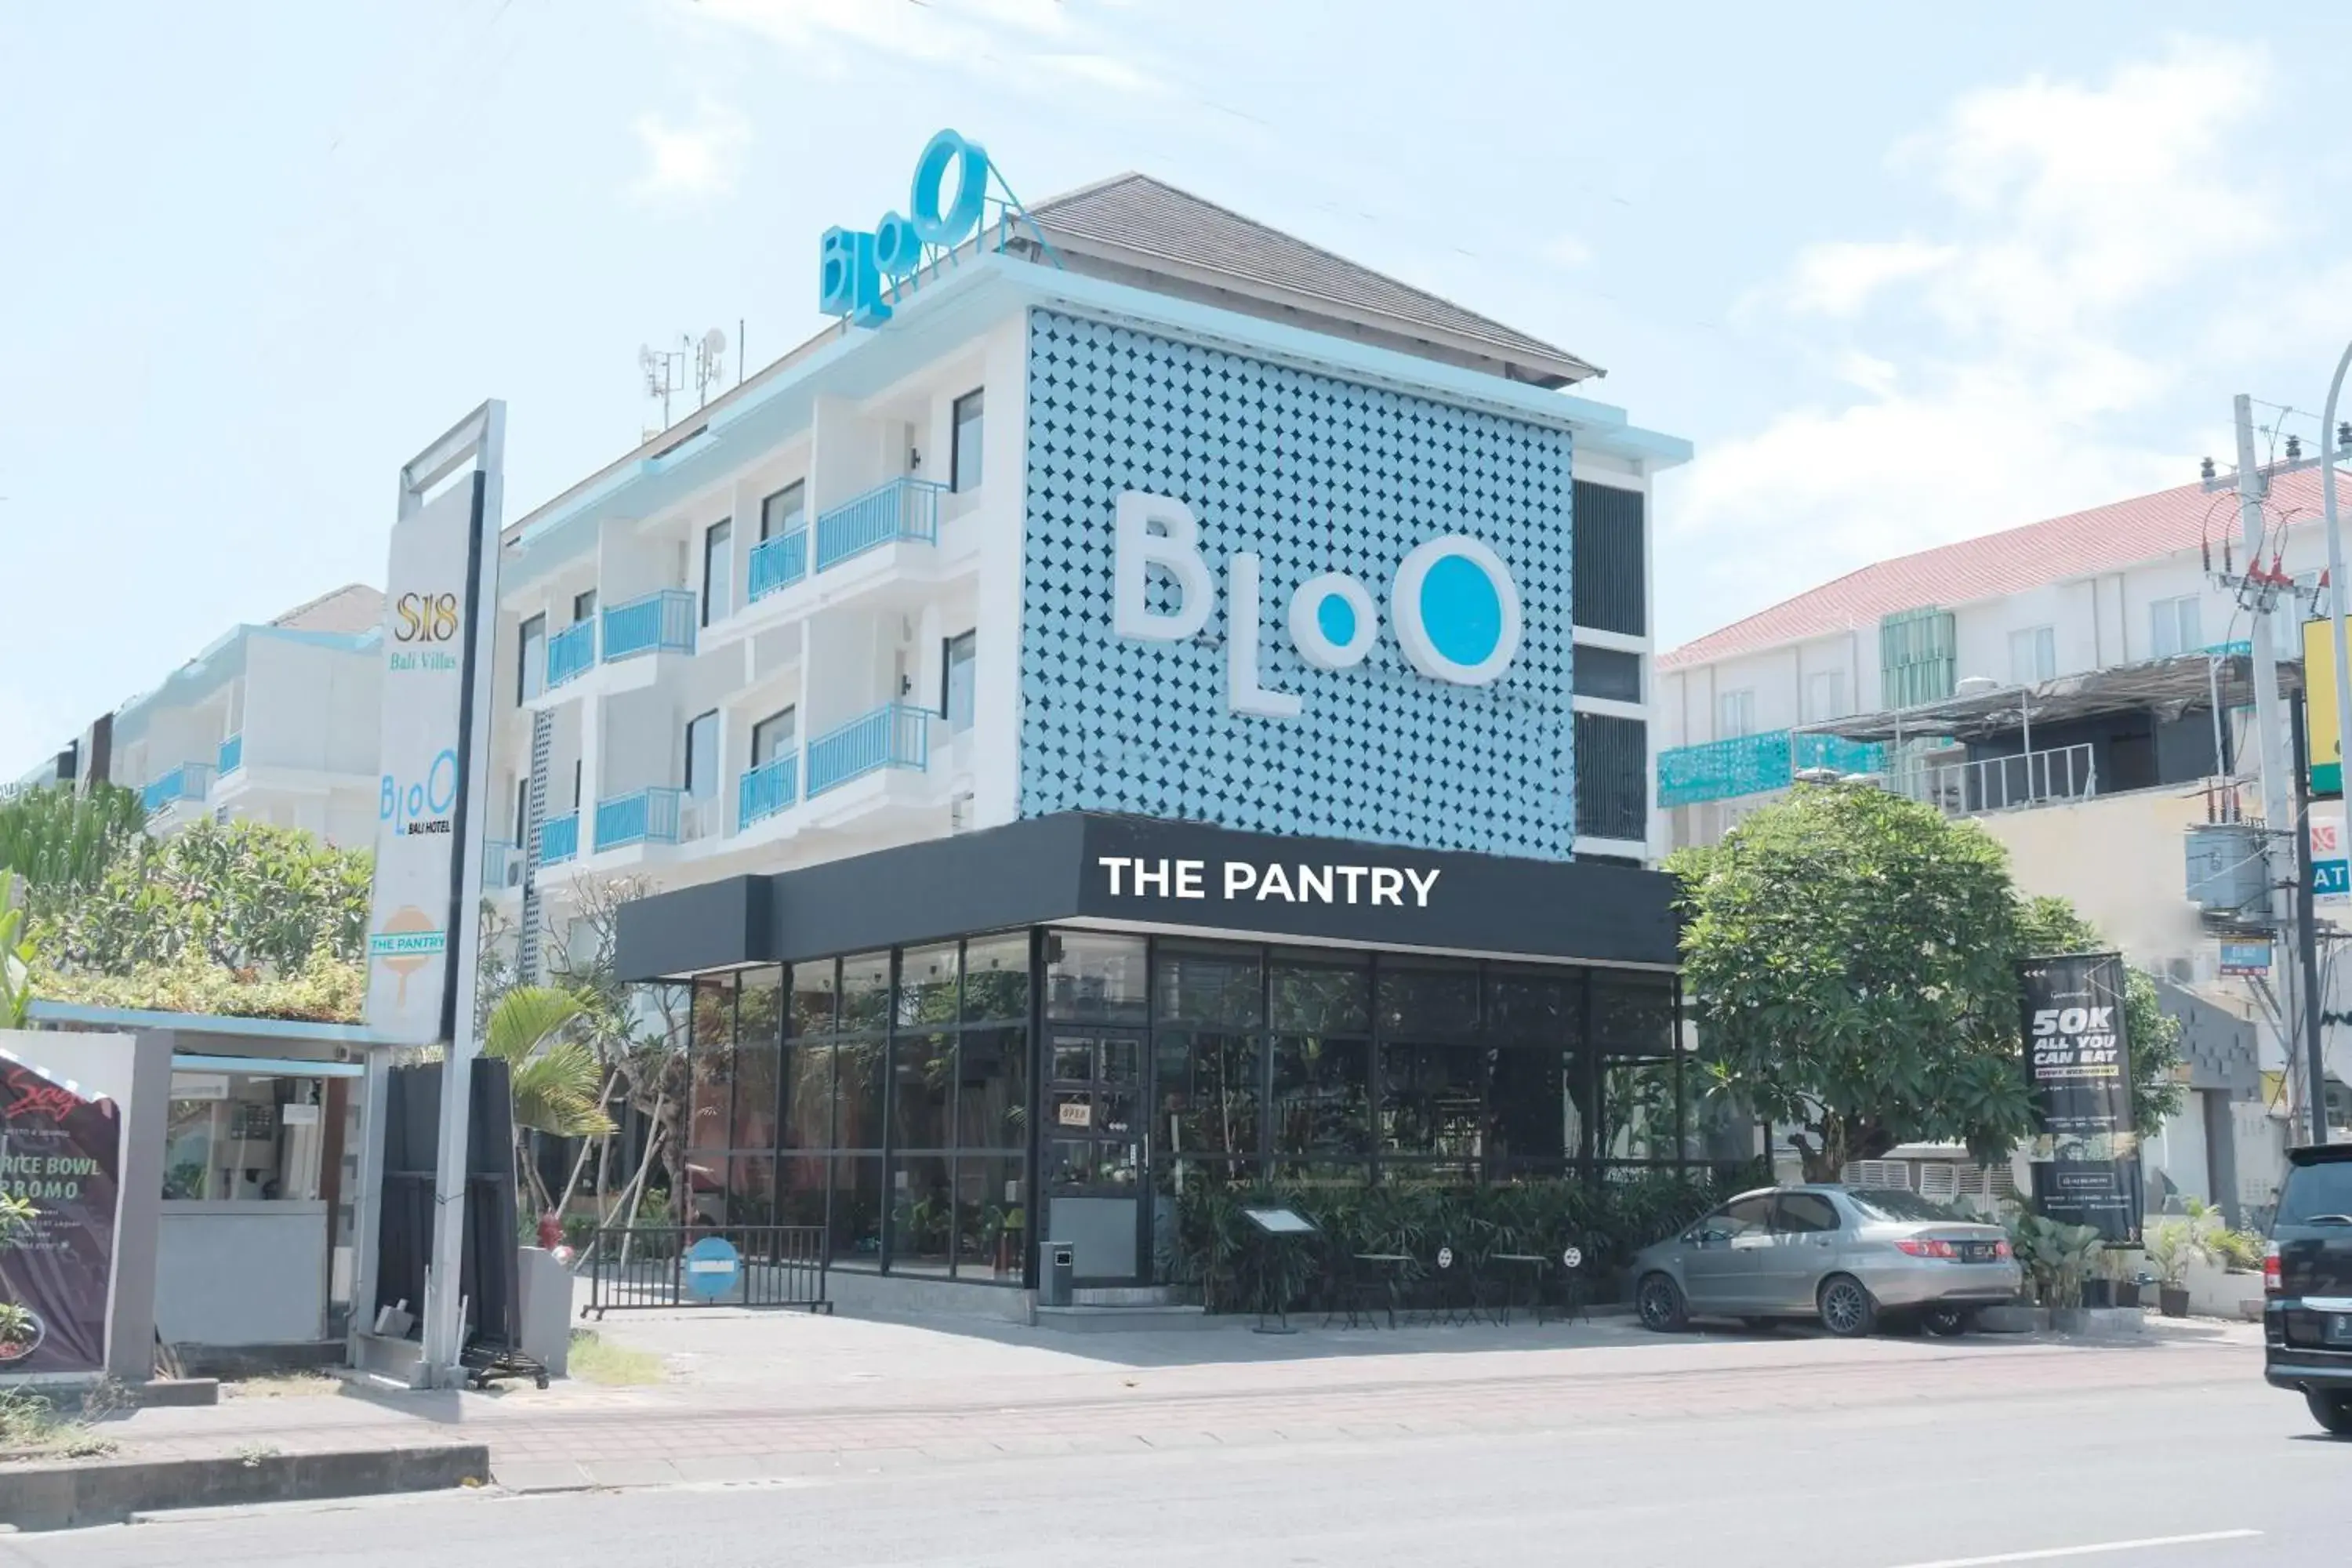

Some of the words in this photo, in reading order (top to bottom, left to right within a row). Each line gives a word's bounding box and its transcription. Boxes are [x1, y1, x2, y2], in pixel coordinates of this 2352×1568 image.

[394, 592, 458, 641] S18
[390, 651, 416, 670] Bali
[426, 820, 451, 833] HOTEL
[1098, 857, 1205, 898] THE
[1223, 863, 1441, 907] PANTRY
[2314, 866, 2347, 887] AT
[372, 938, 394, 950] THE
[397, 936, 445, 949] PANTRY
[2032, 1006, 2114, 1036] 50K
[2034, 1037, 2070, 1051] ALL
[2077, 1035, 2116, 1048] YOU
[2034, 1051, 2074, 1065] CAN
[2080, 1050, 2118, 1063] EAT
[1, 1156, 42, 1174] RICE
[45, 1156, 101, 1175] BOWL
[0, 1179, 78, 1200] PROMO
